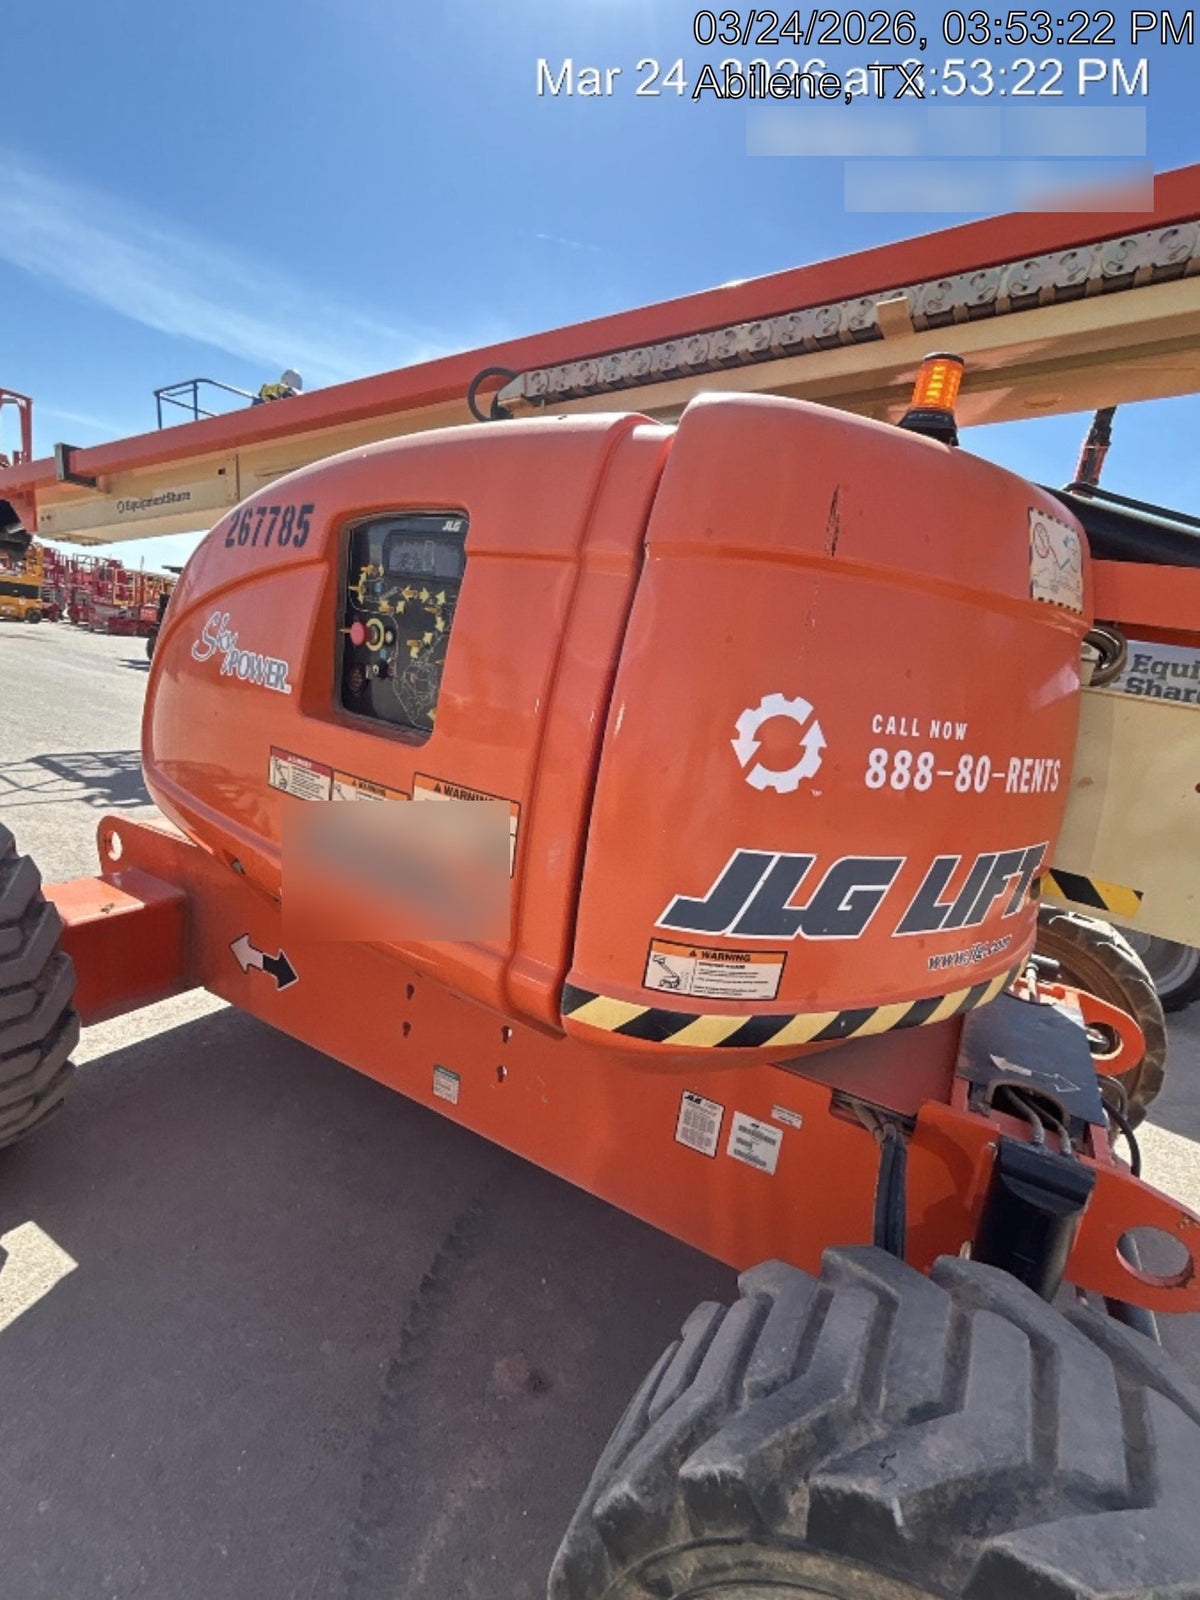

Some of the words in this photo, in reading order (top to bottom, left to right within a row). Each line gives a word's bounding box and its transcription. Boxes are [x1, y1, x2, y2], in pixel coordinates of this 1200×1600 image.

[224, 504, 315, 548] 267785
[442, 520, 462, 532] JLG
[871, 714, 921, 737] CALL
[929, 719, 968, 741] NOW
[864, 747, 1062, 794] 888-80-RENTS
[443, 784, 497, 801] WARNI
[653, 847, 908, 941] JLG
[890, 840, 1050, 938] LIFT
[701, 950, 752, 962] WARNING
